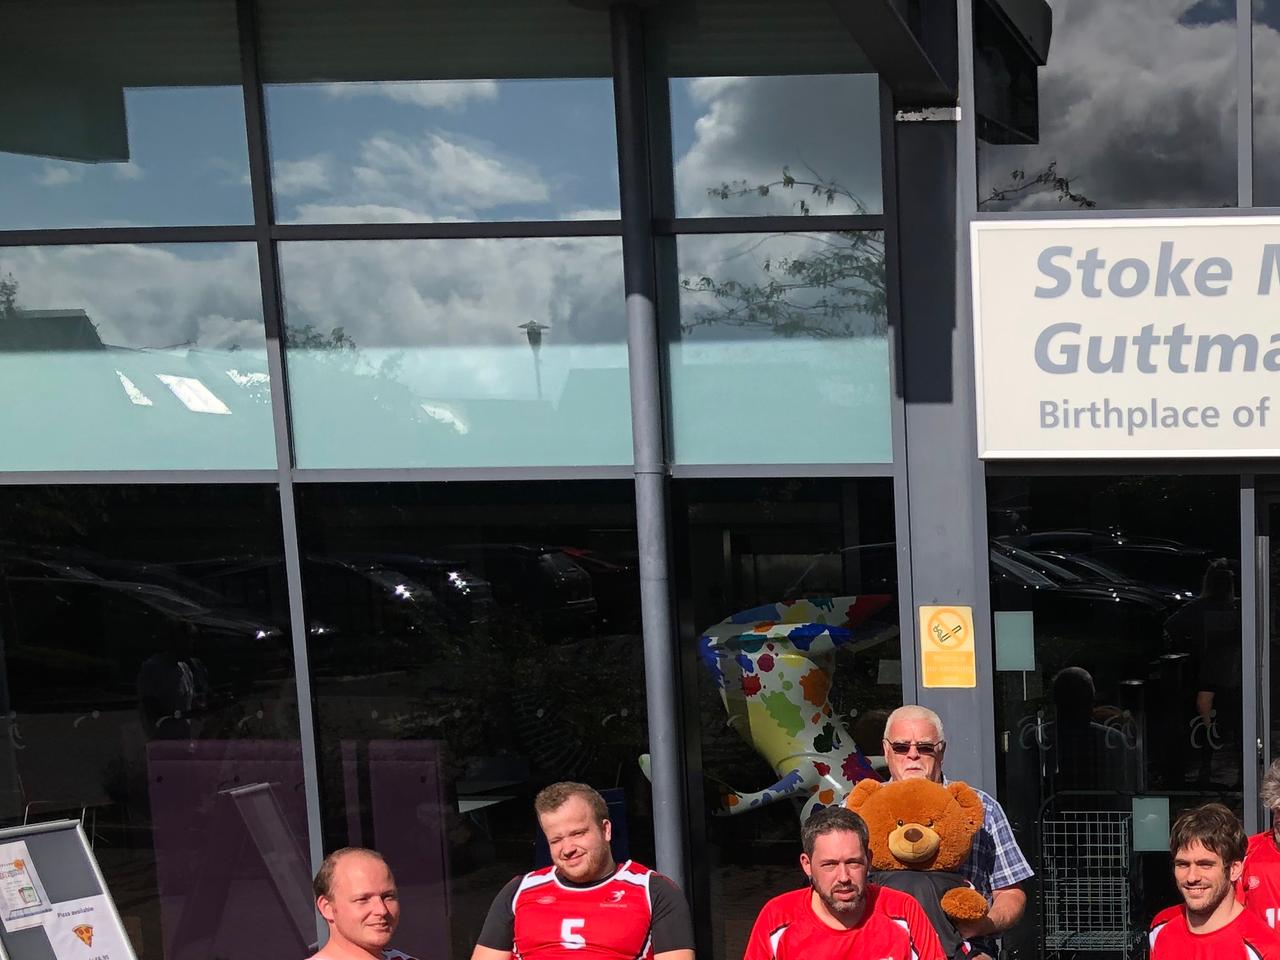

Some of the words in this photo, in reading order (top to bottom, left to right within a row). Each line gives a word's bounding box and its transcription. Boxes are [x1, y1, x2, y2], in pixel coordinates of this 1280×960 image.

[1034, 241, 1233, 298] Stoke
[1039, 399, 1221, 436] Birthplace
[1232, 397, 1272, 429] of
[560, 918, 586, 950] 5
